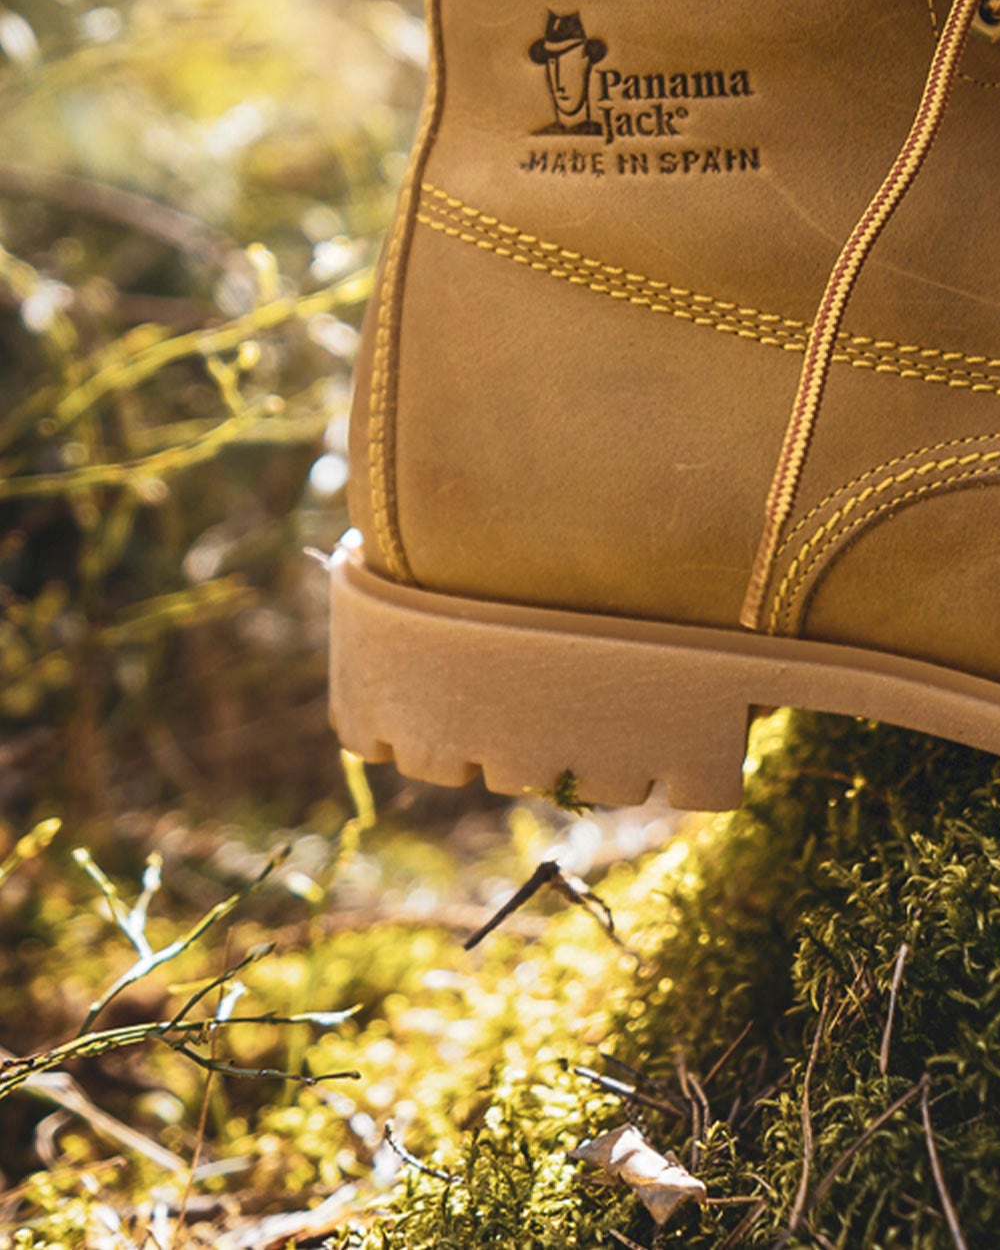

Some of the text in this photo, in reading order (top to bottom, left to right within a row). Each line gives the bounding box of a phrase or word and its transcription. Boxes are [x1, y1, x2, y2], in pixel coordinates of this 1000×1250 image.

[595, 69, 755, 101] Panama
[521, 147, 761, 177] MADE IN SPAIN
